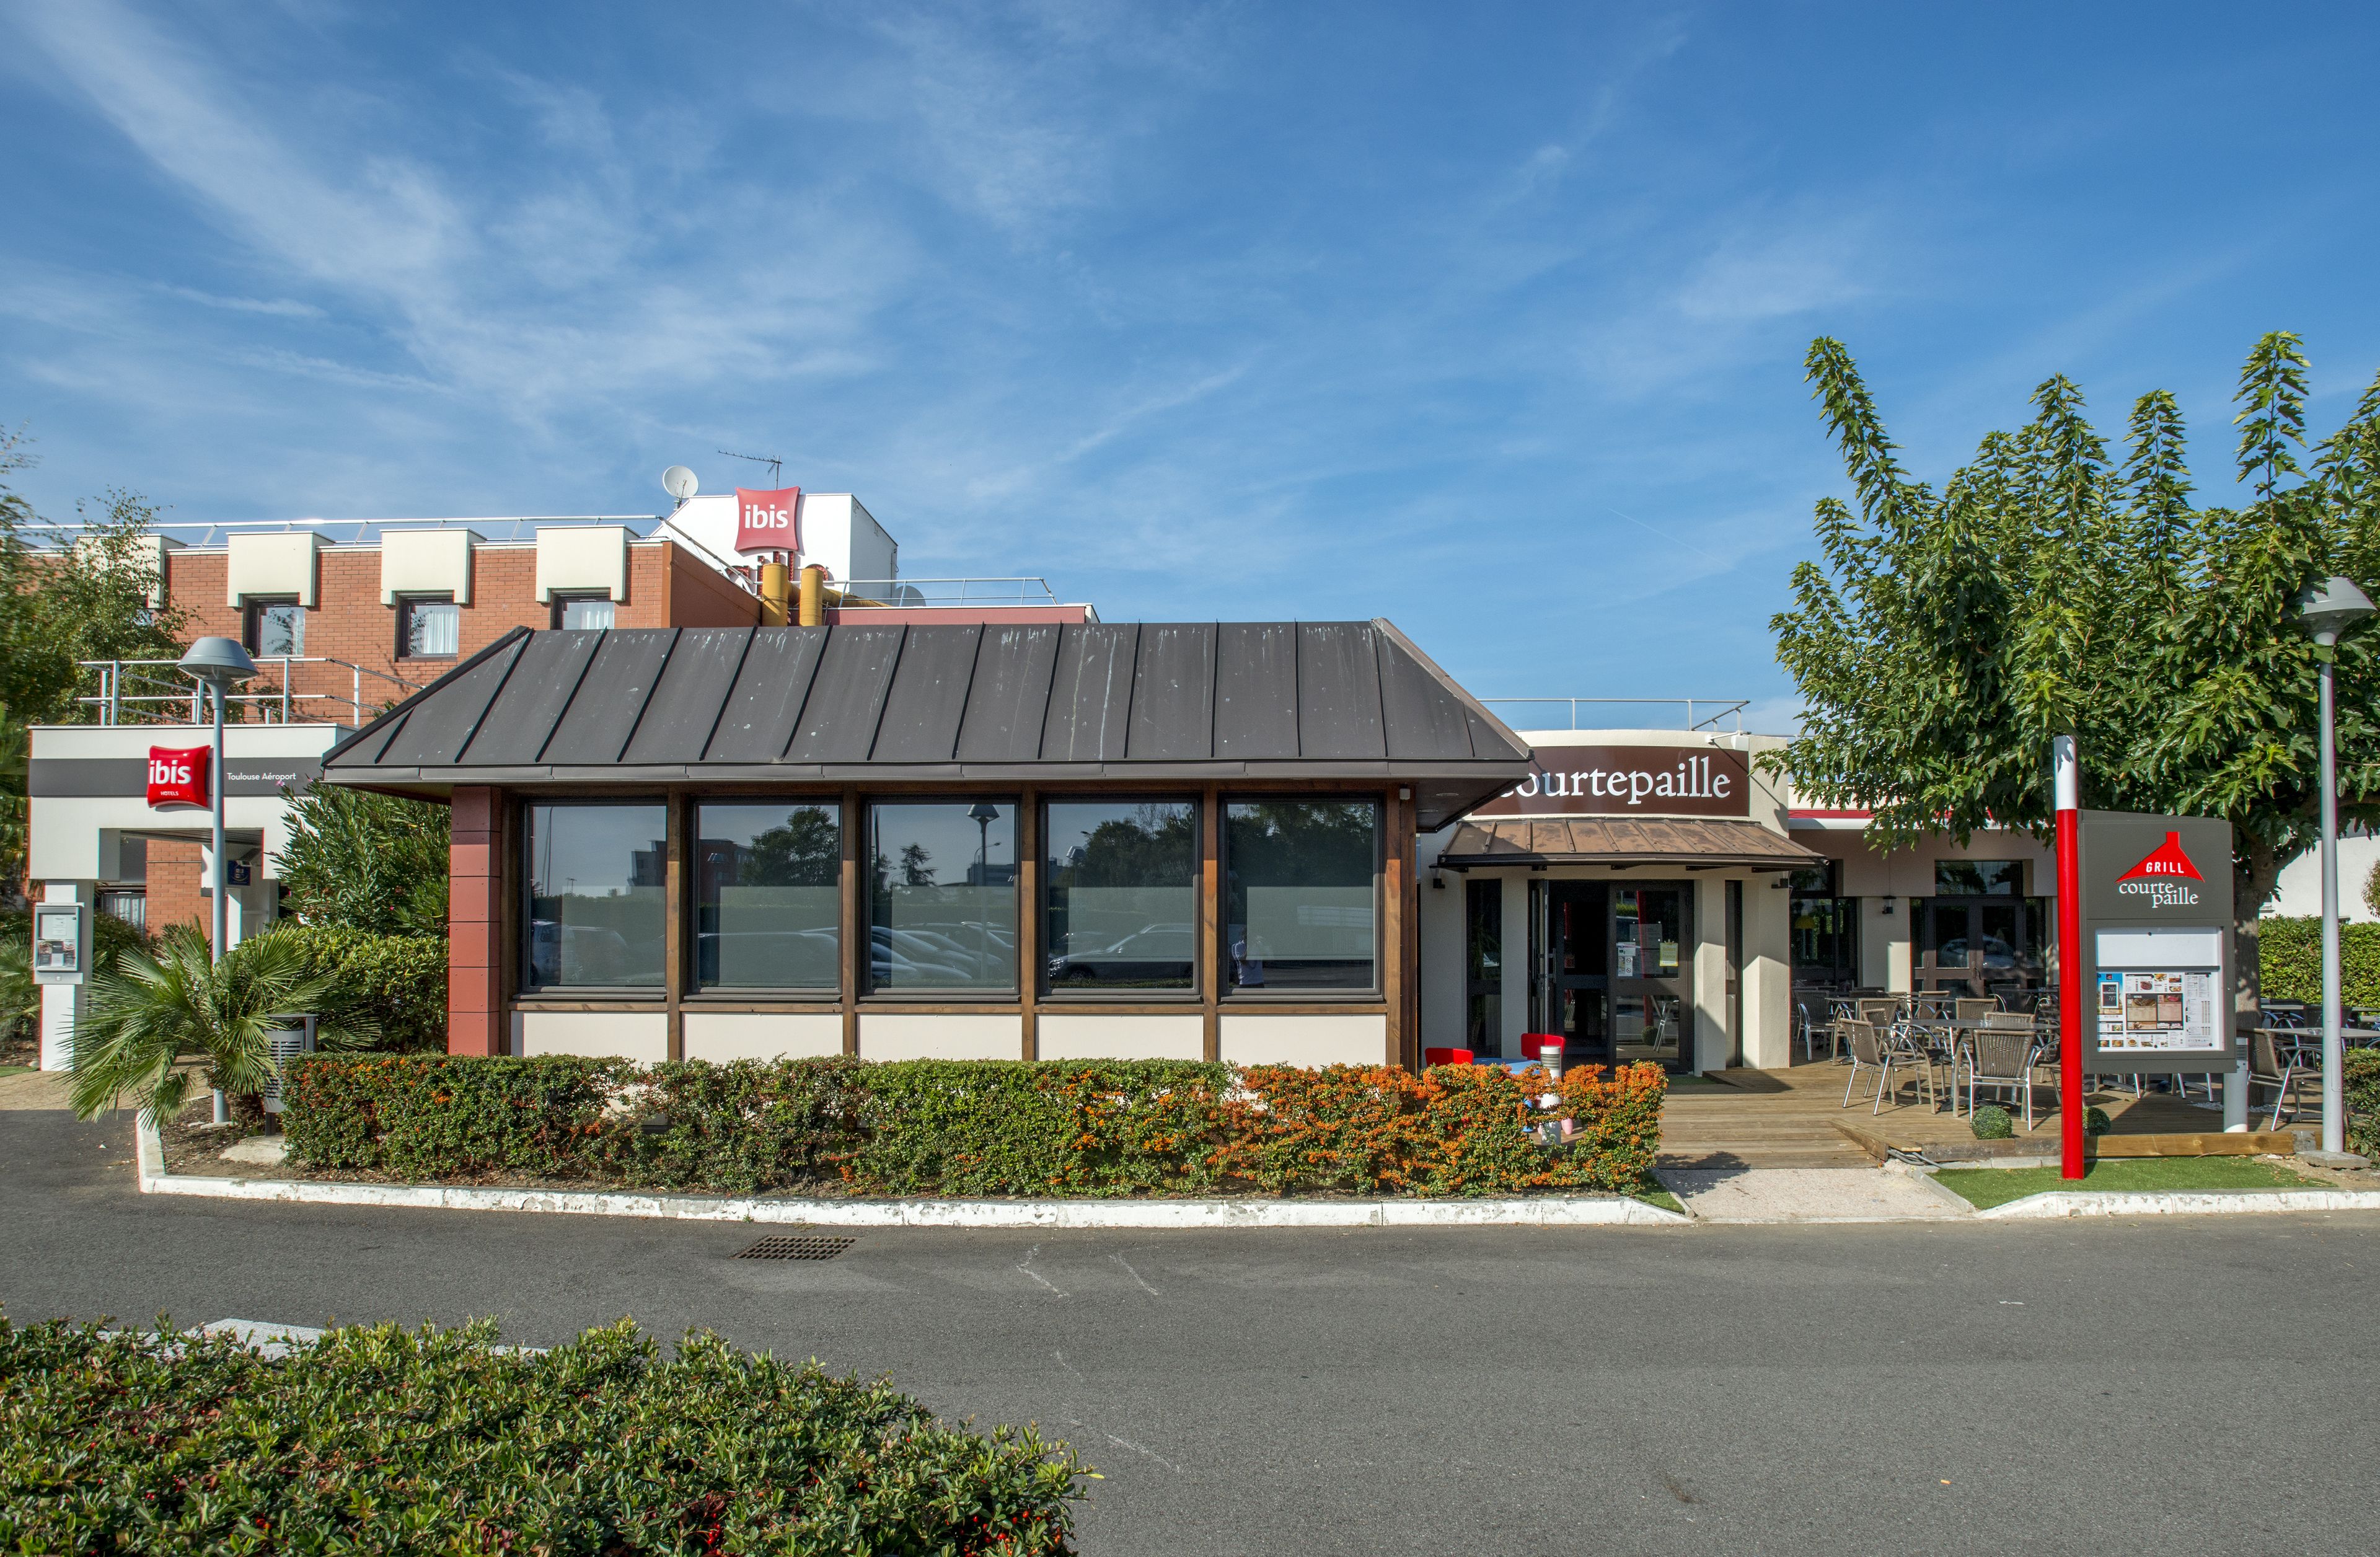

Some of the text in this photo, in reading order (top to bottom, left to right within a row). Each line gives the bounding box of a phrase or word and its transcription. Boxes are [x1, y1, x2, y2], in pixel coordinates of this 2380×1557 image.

[745, 504, 788, 528] ibis
[149, 760, 191, 784] ibis
[262, 772, 296, 782] Aéroport
[1500, 756, 1730, 805] ourtepaille
[2146, 862, 2184, 873] GRILL
[2118, 882, 2174, 894] courte
[2152, 887, 2198, 908] paille
